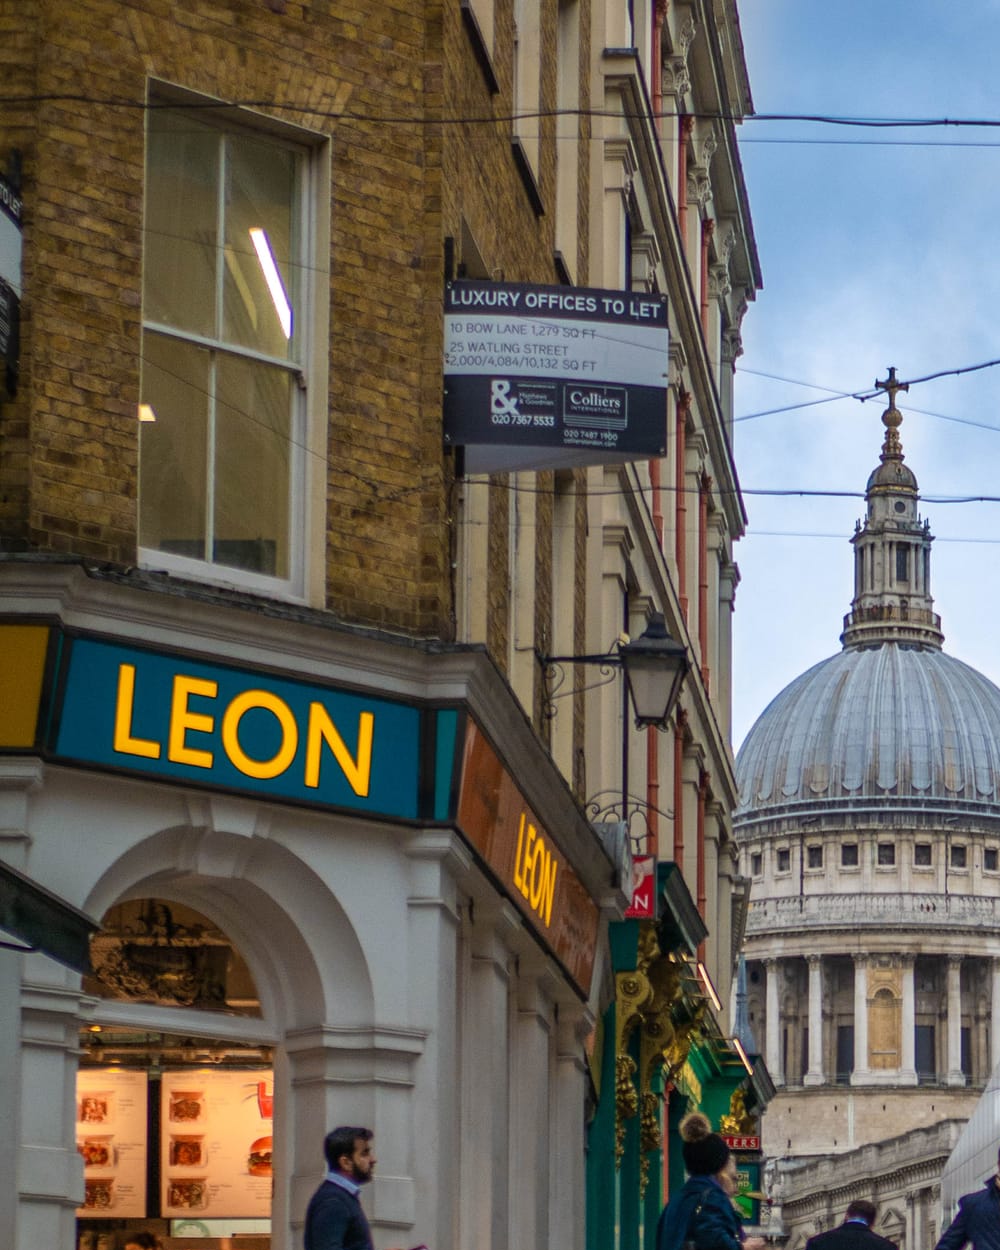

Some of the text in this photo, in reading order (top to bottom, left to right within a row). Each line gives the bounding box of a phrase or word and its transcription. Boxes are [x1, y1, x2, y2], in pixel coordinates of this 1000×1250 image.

[451, 289, 661, 319] LUXURY OFFICES TO LET
[450, 322, 597, 340] 10 BOW LANE 1,279 SQ FT
[450, 342, 569, 357] 25 WATLING STREET
[563, 359, 579, 371] SQ
[582, 360, 597, 371] FT
[570, 391, 621, 408] Colliers
[571, 405, 620, 414] INTERNATIONAL
[491, 414, 555, 427] 020 7367 5533
[564, 430, 579, 438] 020
[112, 663, 374, 797] LEON
[512, 812, 558, 929] LEON
